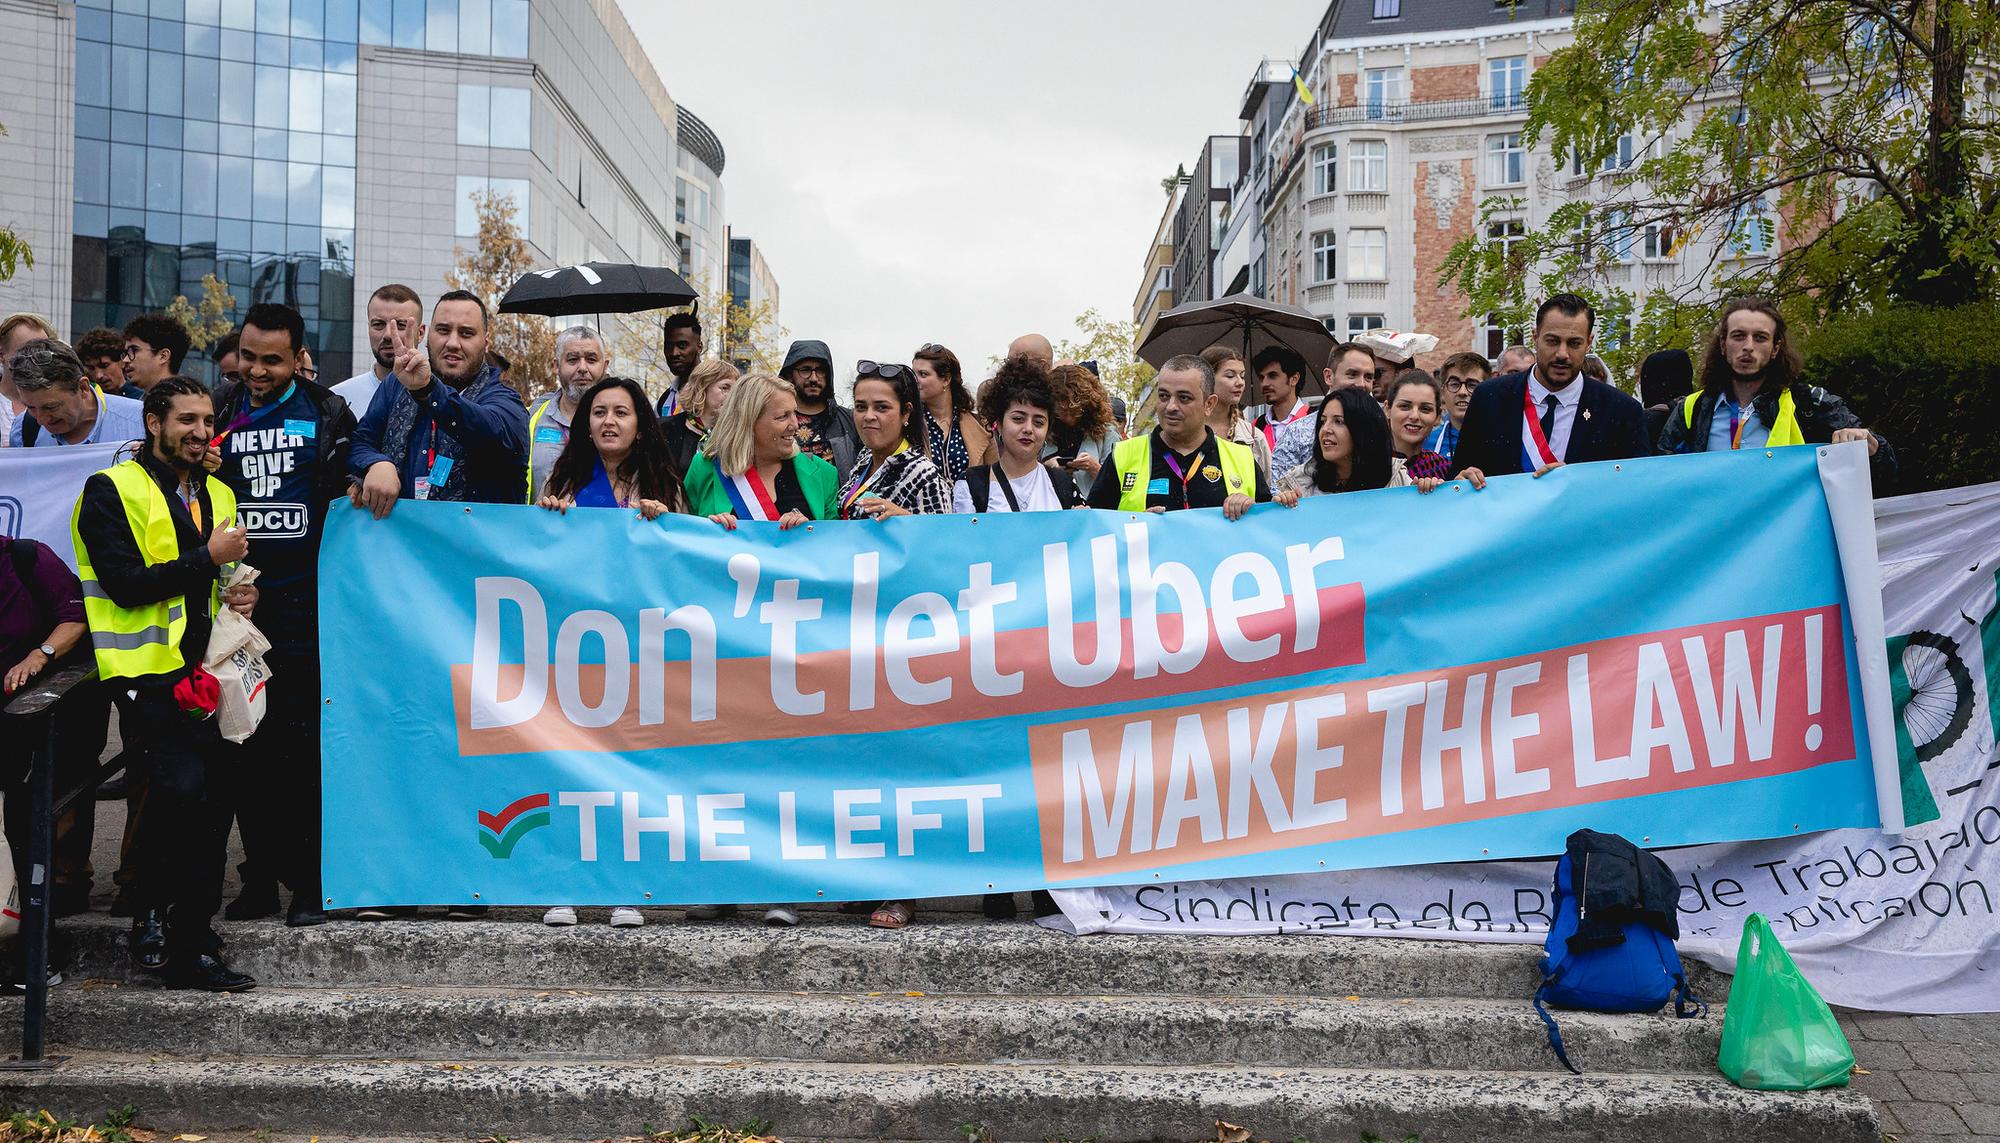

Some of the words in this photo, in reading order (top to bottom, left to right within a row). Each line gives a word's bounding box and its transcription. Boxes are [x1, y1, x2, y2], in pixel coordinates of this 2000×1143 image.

[231, 428, 304, 453] NEVER
[241, 451, 294, 479] GIVE
[251, 476, 281, 497] UP
[471, 553, 825, 729] Don't
[849, 551, 1024, 711] let
[1042, 522, 1345, 688] Uber
[1061, 692, 1348, 865] MAKE
[1368, 662, 1550, 818] THE
[558, 791, 751, 862] THE
[778, 784, 1002, 860] LEFT
